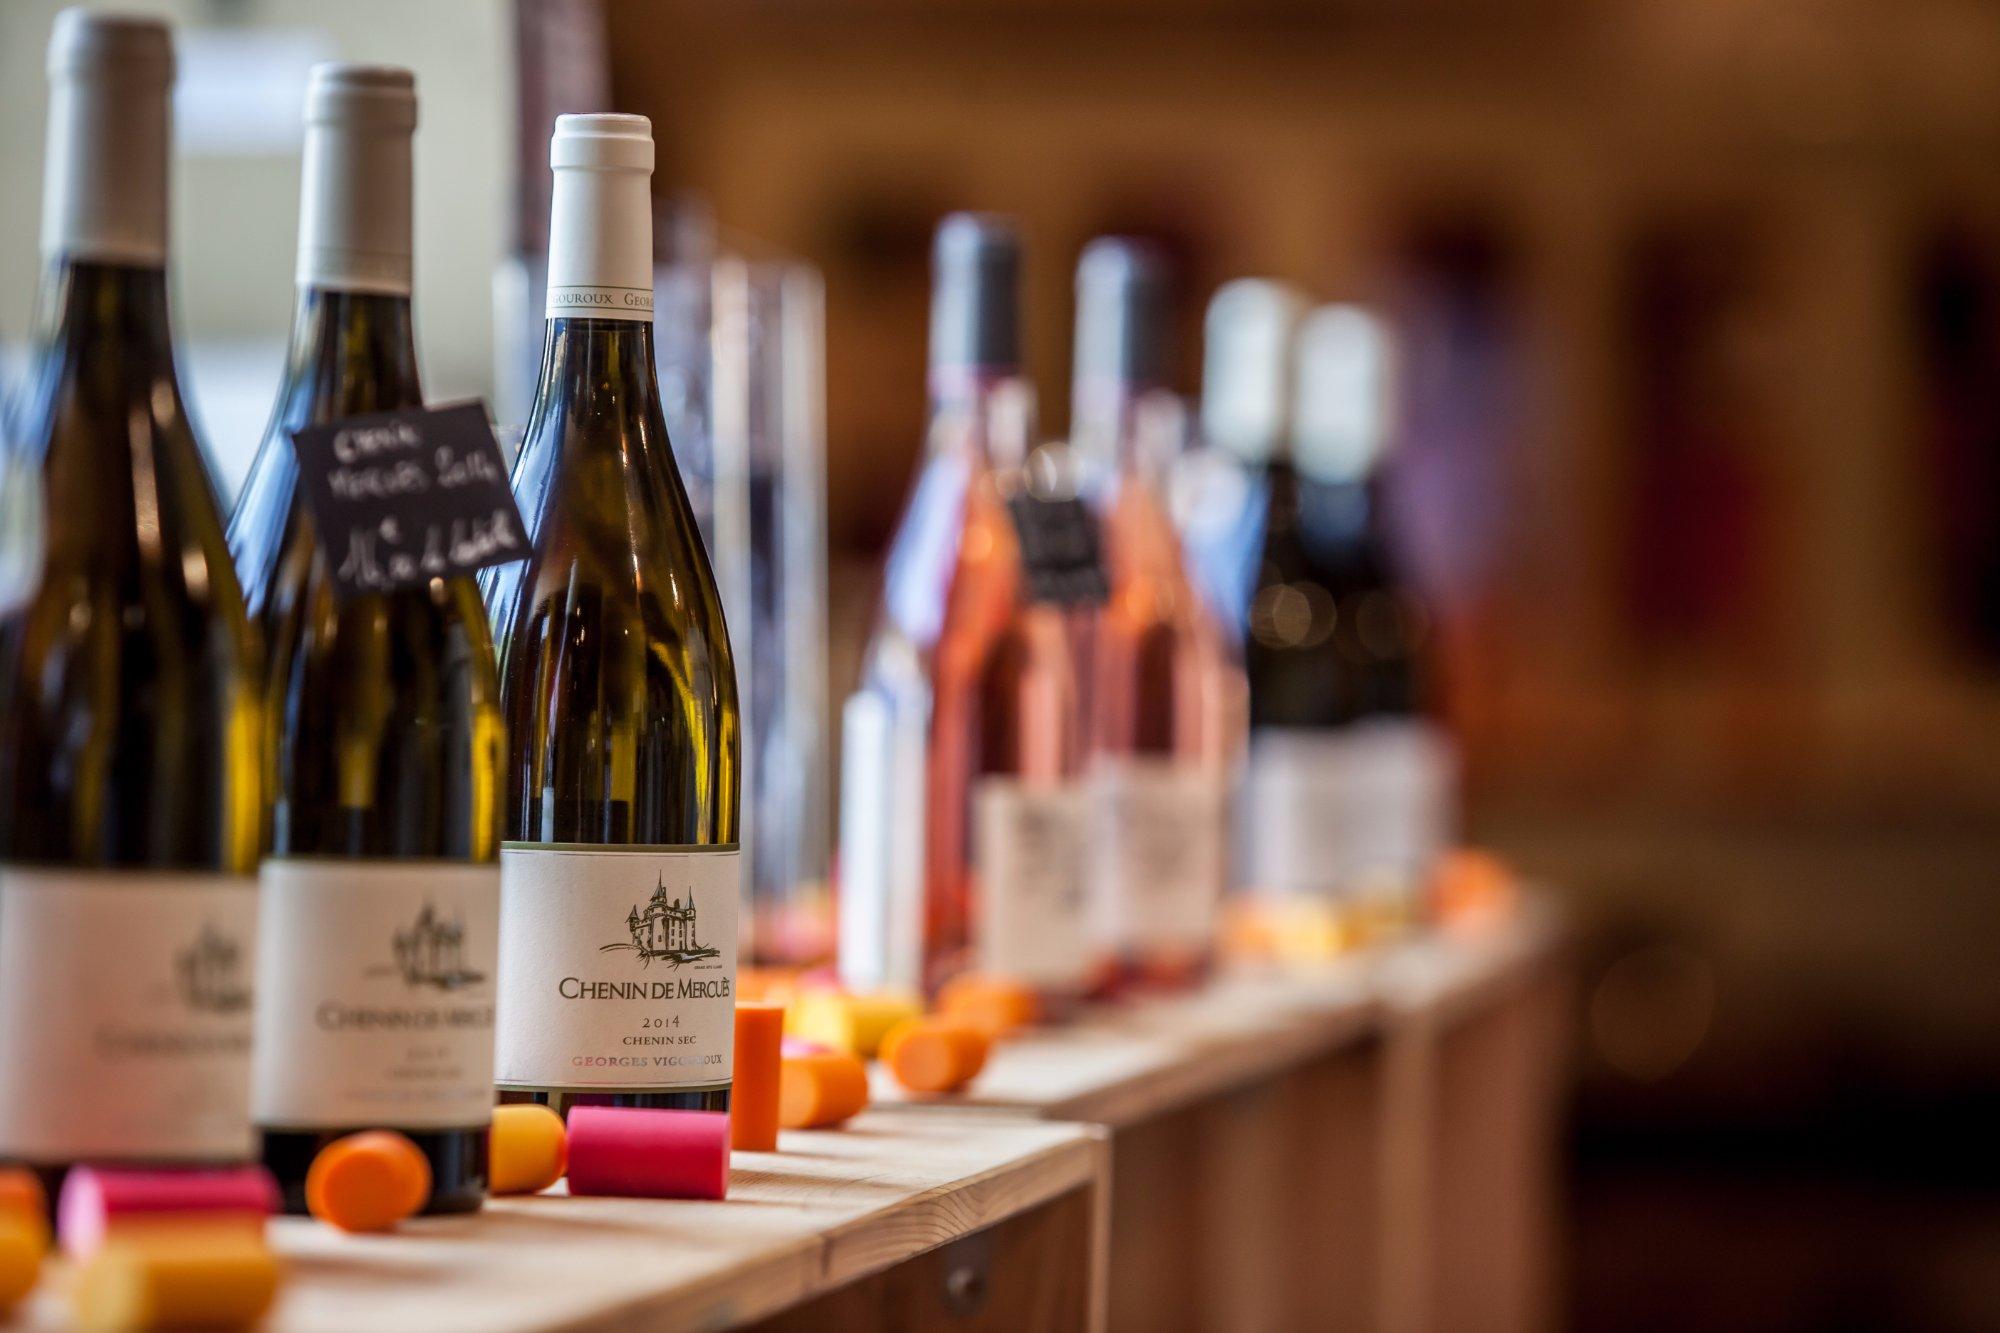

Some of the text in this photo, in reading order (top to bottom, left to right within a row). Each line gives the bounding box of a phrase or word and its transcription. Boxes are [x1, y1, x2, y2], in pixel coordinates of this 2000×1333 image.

[558, 976, 648, 1000] CHENIN
[651, 981, 675, 1000] DE
[641, 1014, 681, 1029] 2014
[622, 1035, 698, 1046] CHENIN SEC
[571, 1055, 649, 1067] GEORGES
